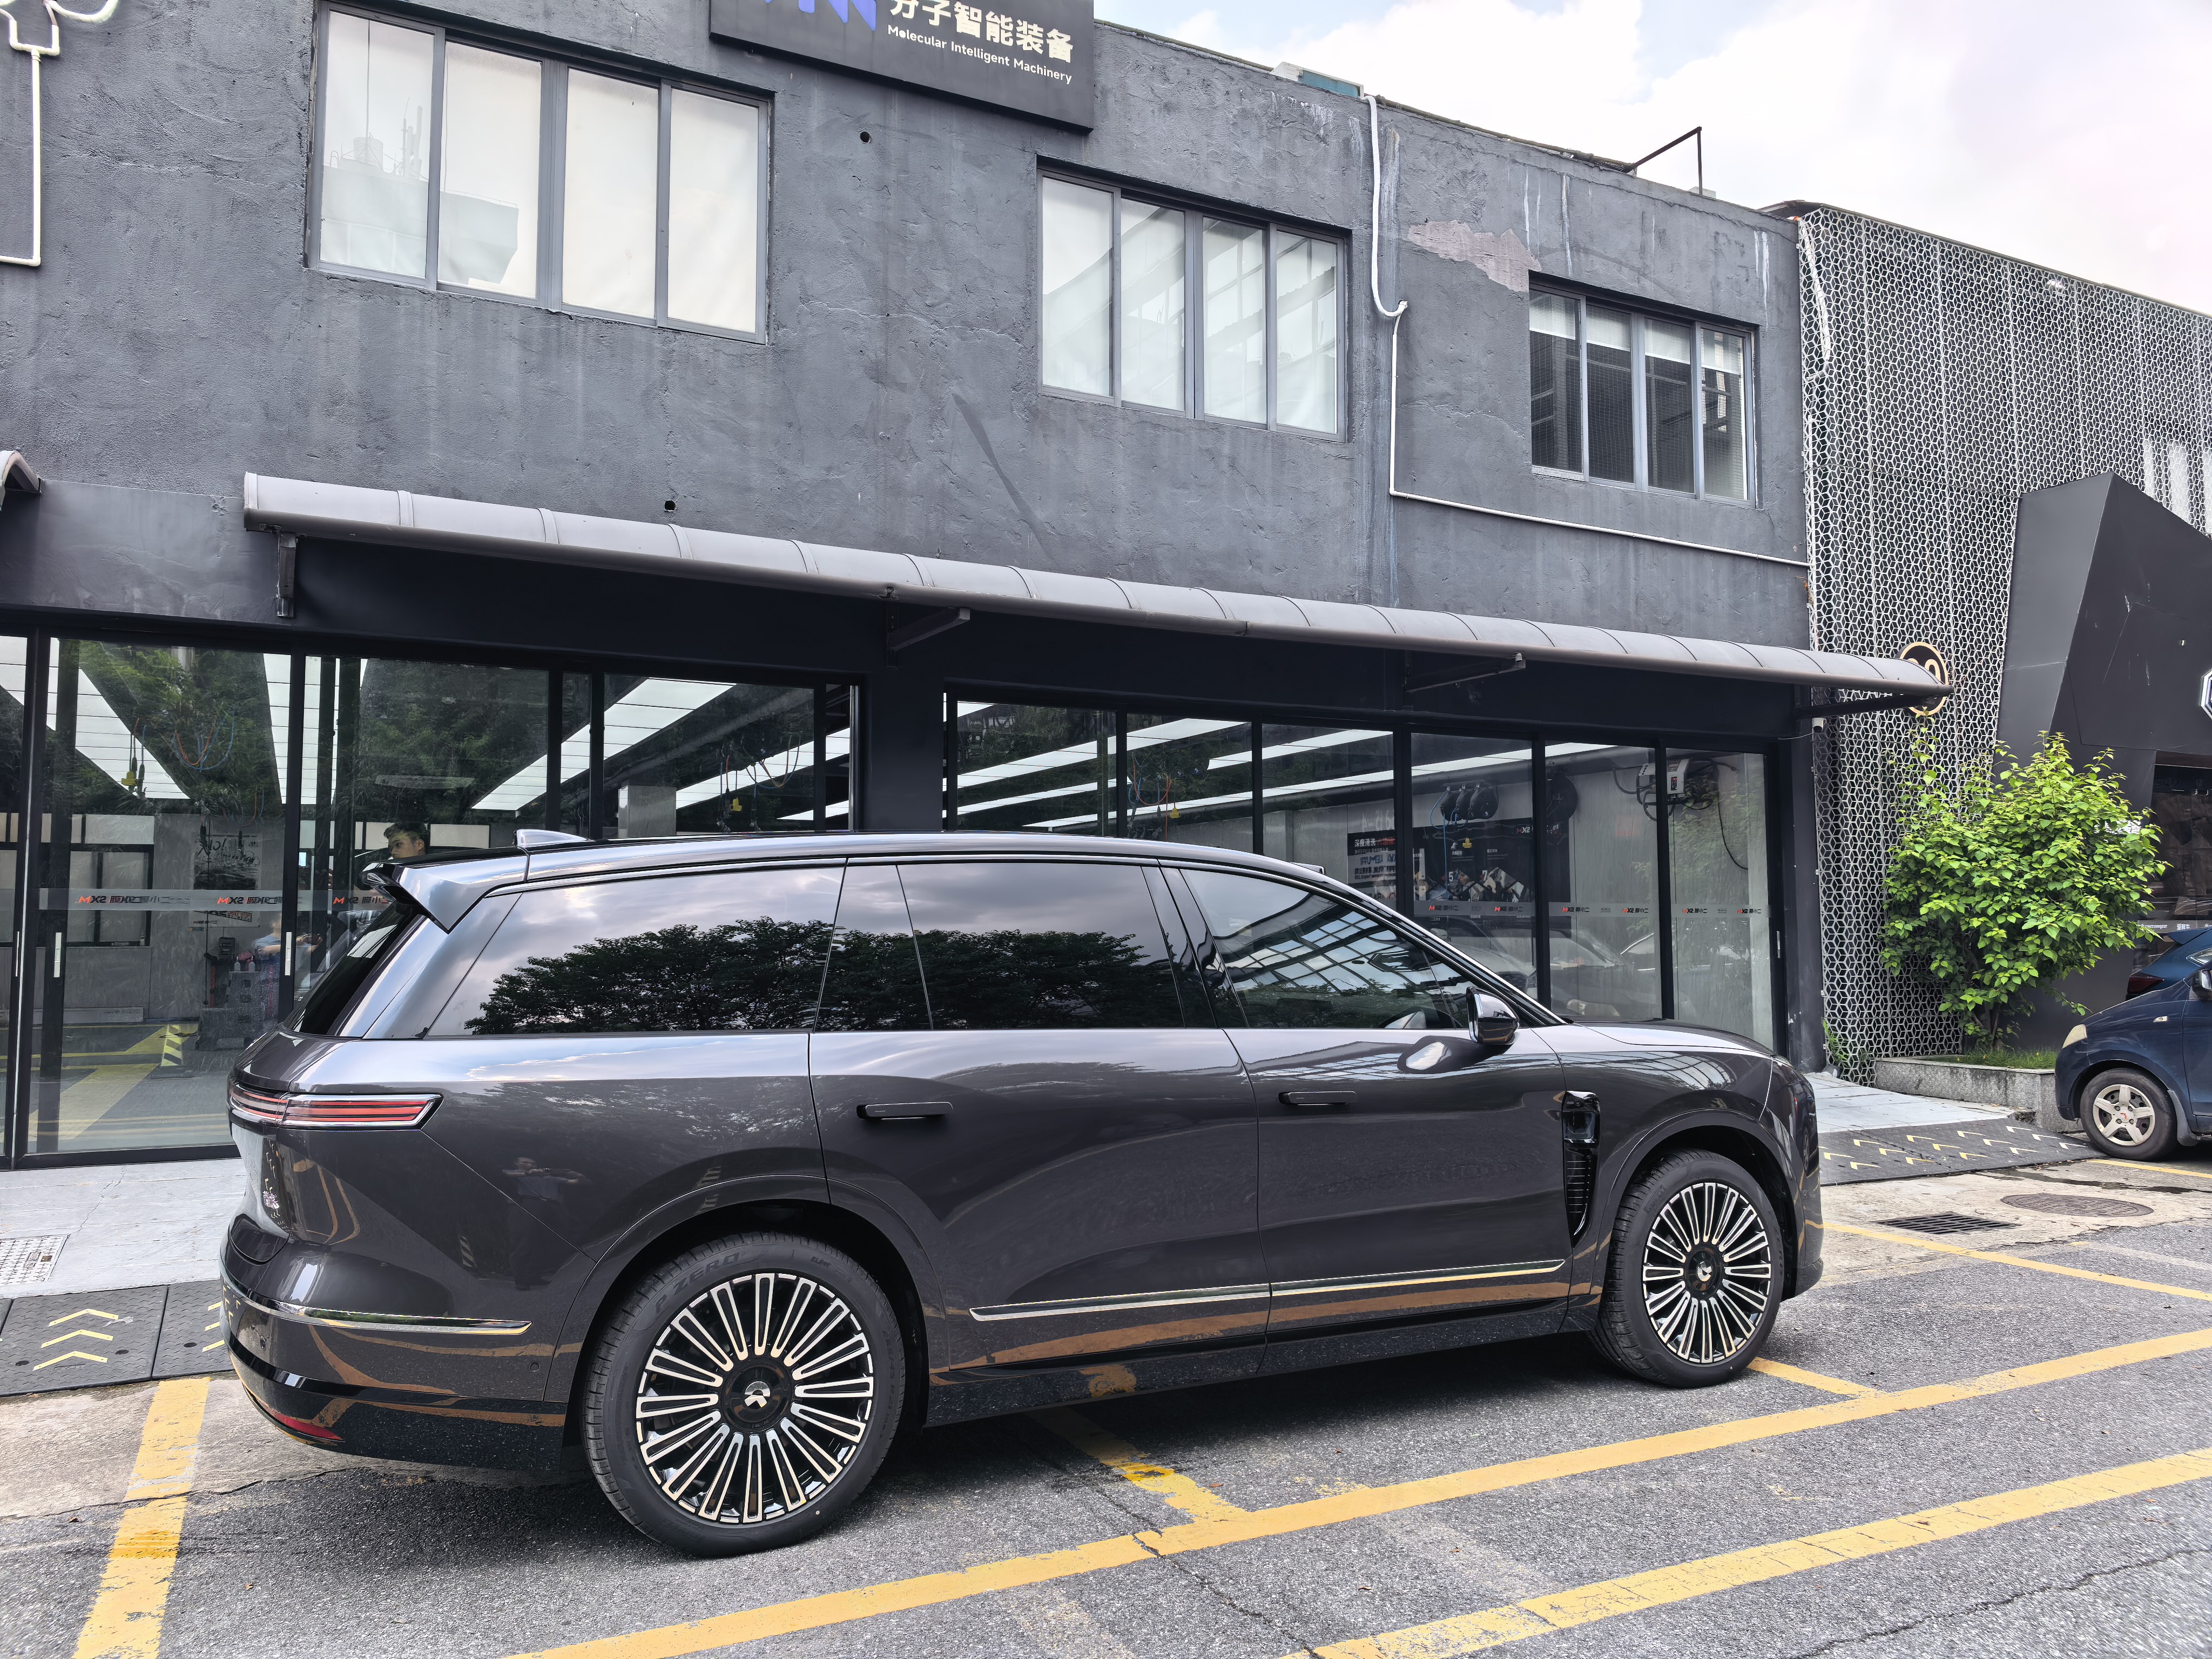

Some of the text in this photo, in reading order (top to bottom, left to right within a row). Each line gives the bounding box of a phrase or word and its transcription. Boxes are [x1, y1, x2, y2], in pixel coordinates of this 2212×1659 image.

[890, 0, 1074, 63] 分子智能装备
[887, 24, 1072, 85] Molecular Intelligent Machinery
[1448, 871, 1453, 882] 5
[1482, 870, 1488, 881] 7
